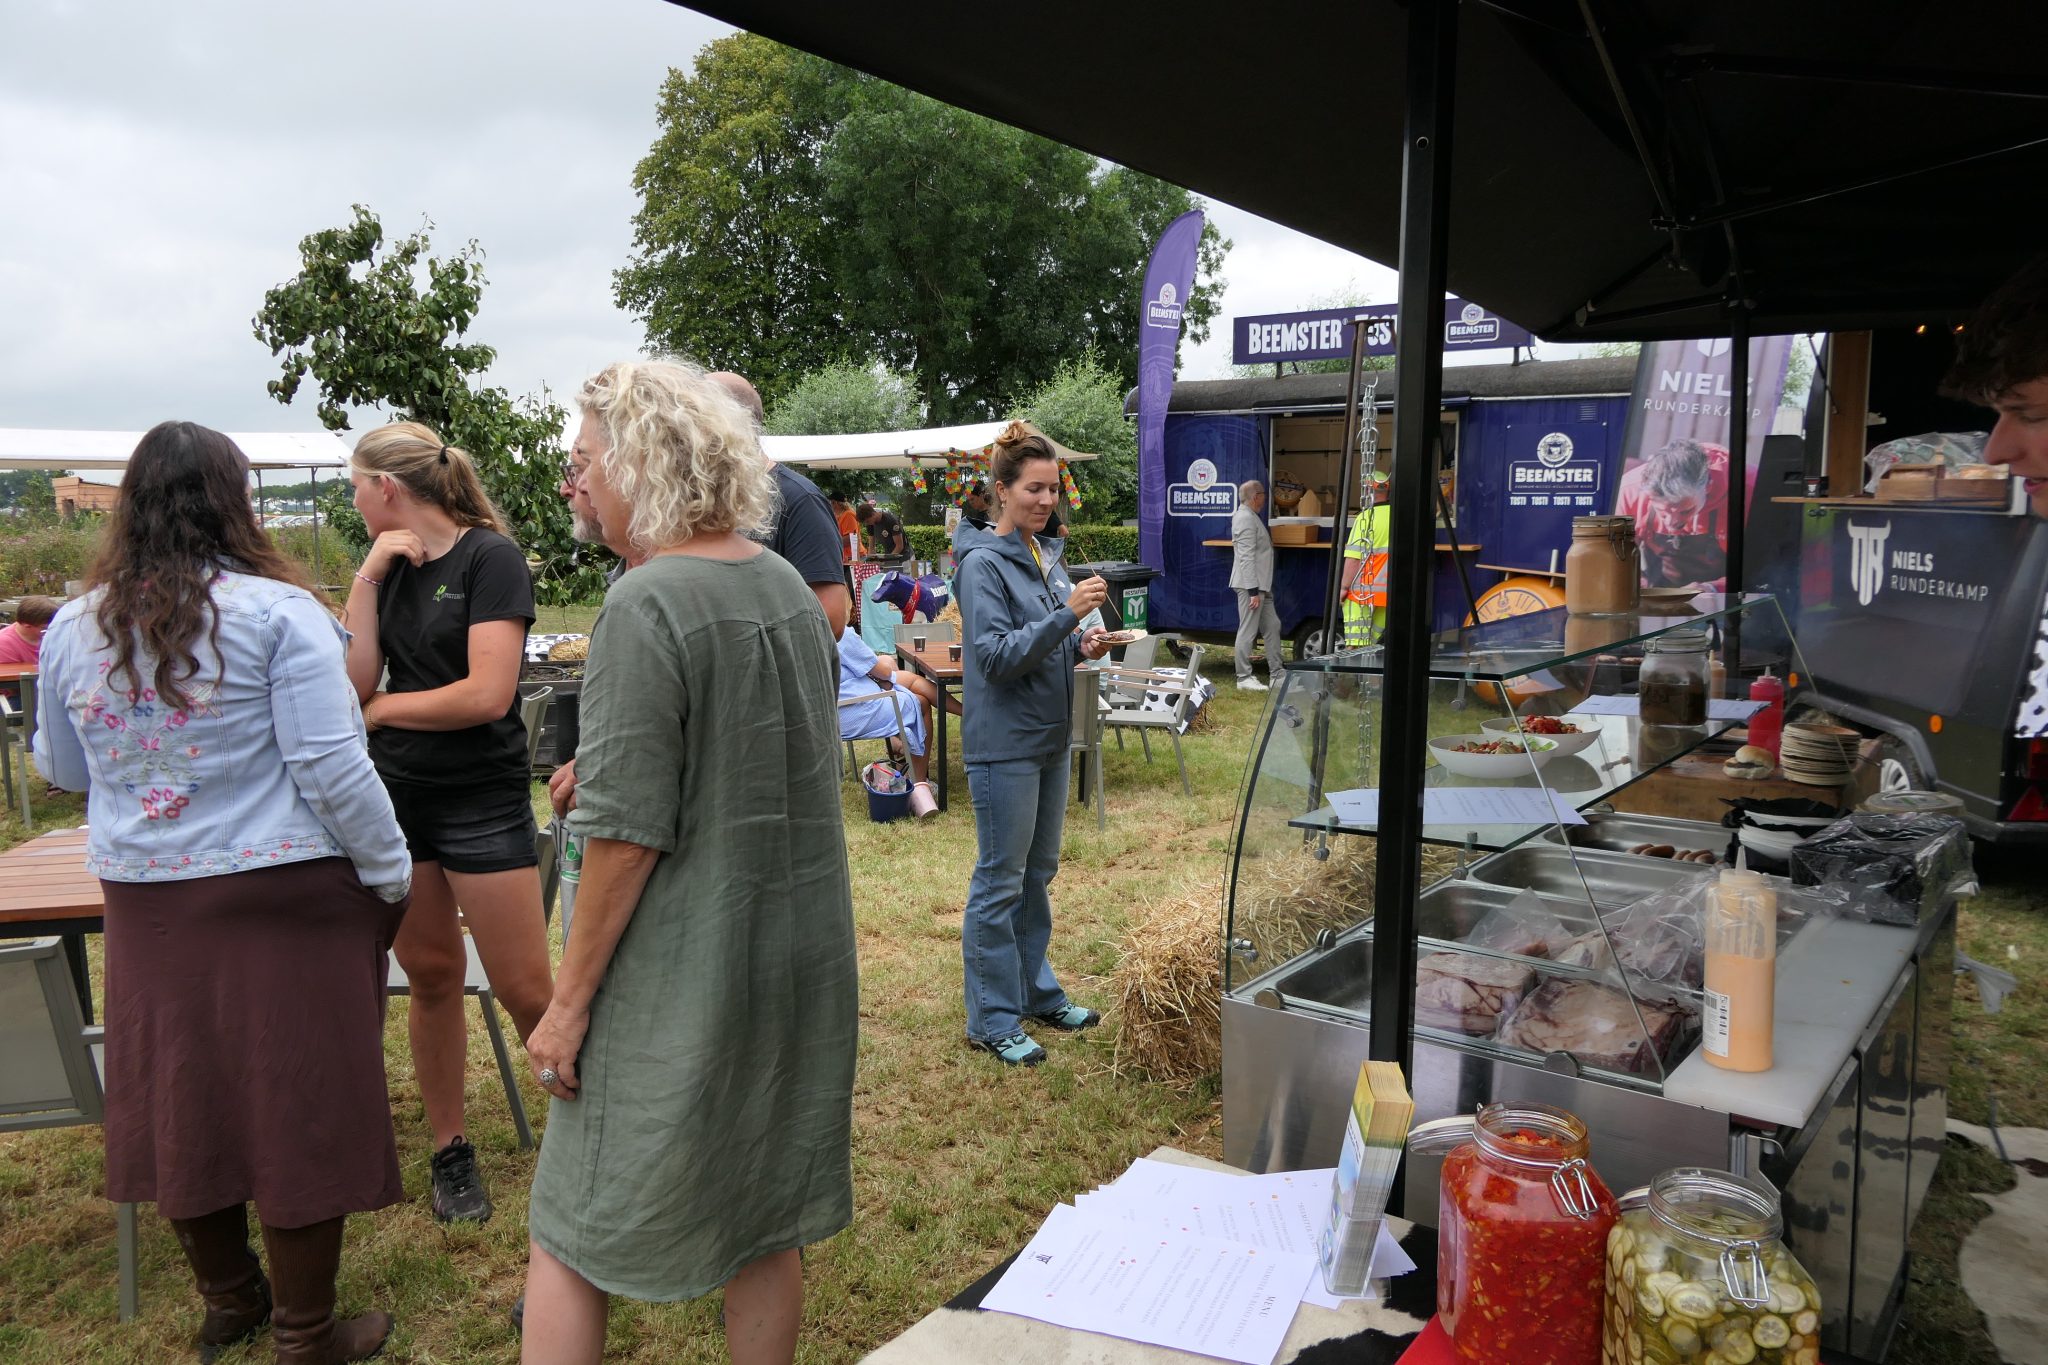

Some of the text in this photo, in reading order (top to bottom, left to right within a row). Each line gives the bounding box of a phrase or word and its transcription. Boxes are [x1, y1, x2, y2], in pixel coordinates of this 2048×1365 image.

[1450, 324, 1494, 336] BEEMSTER
[1644, 398, 1761, 419] RUNDERKAP
[1515, 467, 1593, 482] BEEMSTER
[1174, 491, 1231, 504] BEEMSTER
[1892, 550, 1934, 573] NIELS
[1891, 575, 1989, 601] RUNDERKAMP
